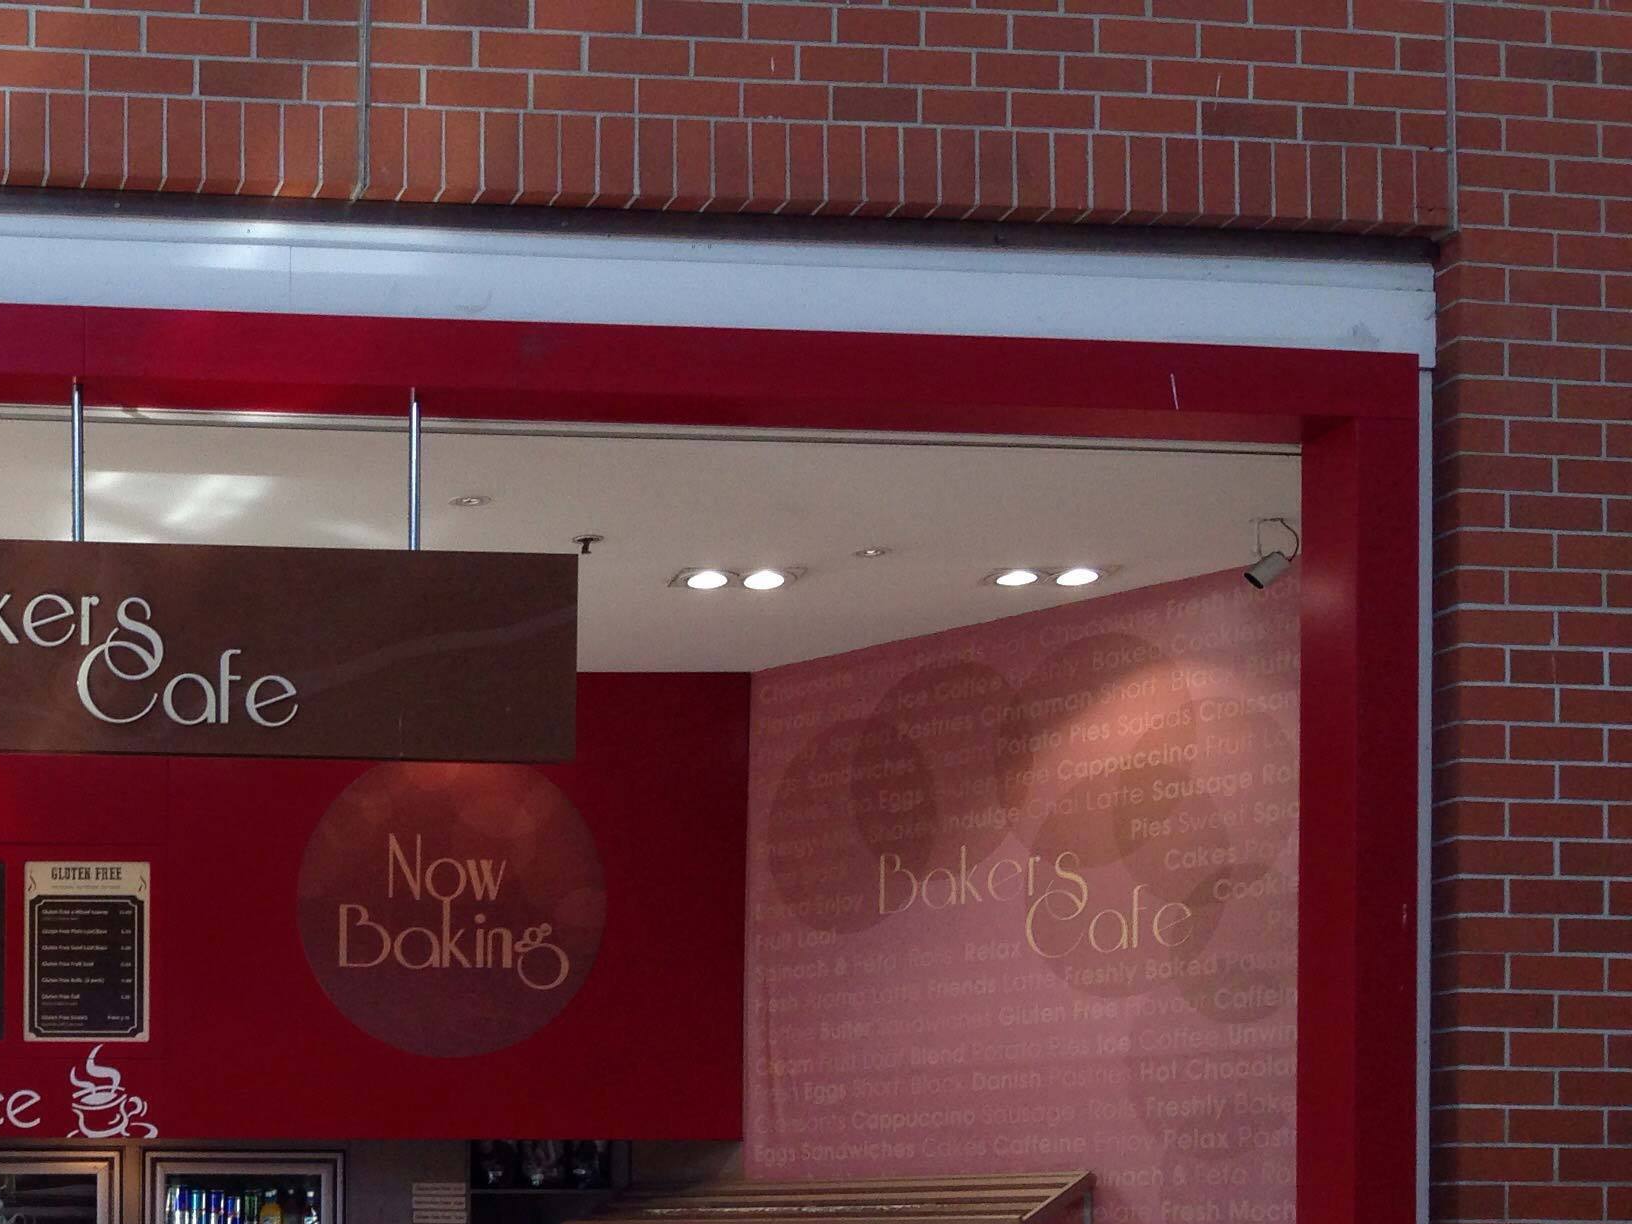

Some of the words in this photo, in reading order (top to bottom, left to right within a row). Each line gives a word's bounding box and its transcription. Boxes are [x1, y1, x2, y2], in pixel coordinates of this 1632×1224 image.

[76, 639, 299, 728] Cafe
[1070, 721, 1111, 744] Pies
[1118, 706, 1192, 736] Salads
[1057, 742, 1198, 781] Cappuccino
[1152, 770, 1253, 802] Sausage
[1131, 817, 1172, 840] Pies
[51, 866, 92, 881] GLUTEN
[94, 867, 123, 881] FREE
[388, 832, 507, 900] Now
[1164, 844, 1237, 871] Cakes
[878, 844, 1088, 920] Bakers
[1025, 884, 1194, 959] Cafe
[338, 899, 570, 990] Baking
[964, 940, 1023, 962] Relax
[972, 1069, 1042, 1092] Danish
[1139, 1059, 1178, 1082] Hot
[851, 1106, 976, 1133] Cappuccino
[1145, 1093, 1228, 1121] Freshly
[754, 1143, 796, 1167] Eggs
[800, 1140, 915, 1161] Sandwiches
[992, 1131, 1086, 1157] Caffeine
[1162, 1127, 1229, 1151] Relax
[1161, 1198, 1220, 1220] Fresh
